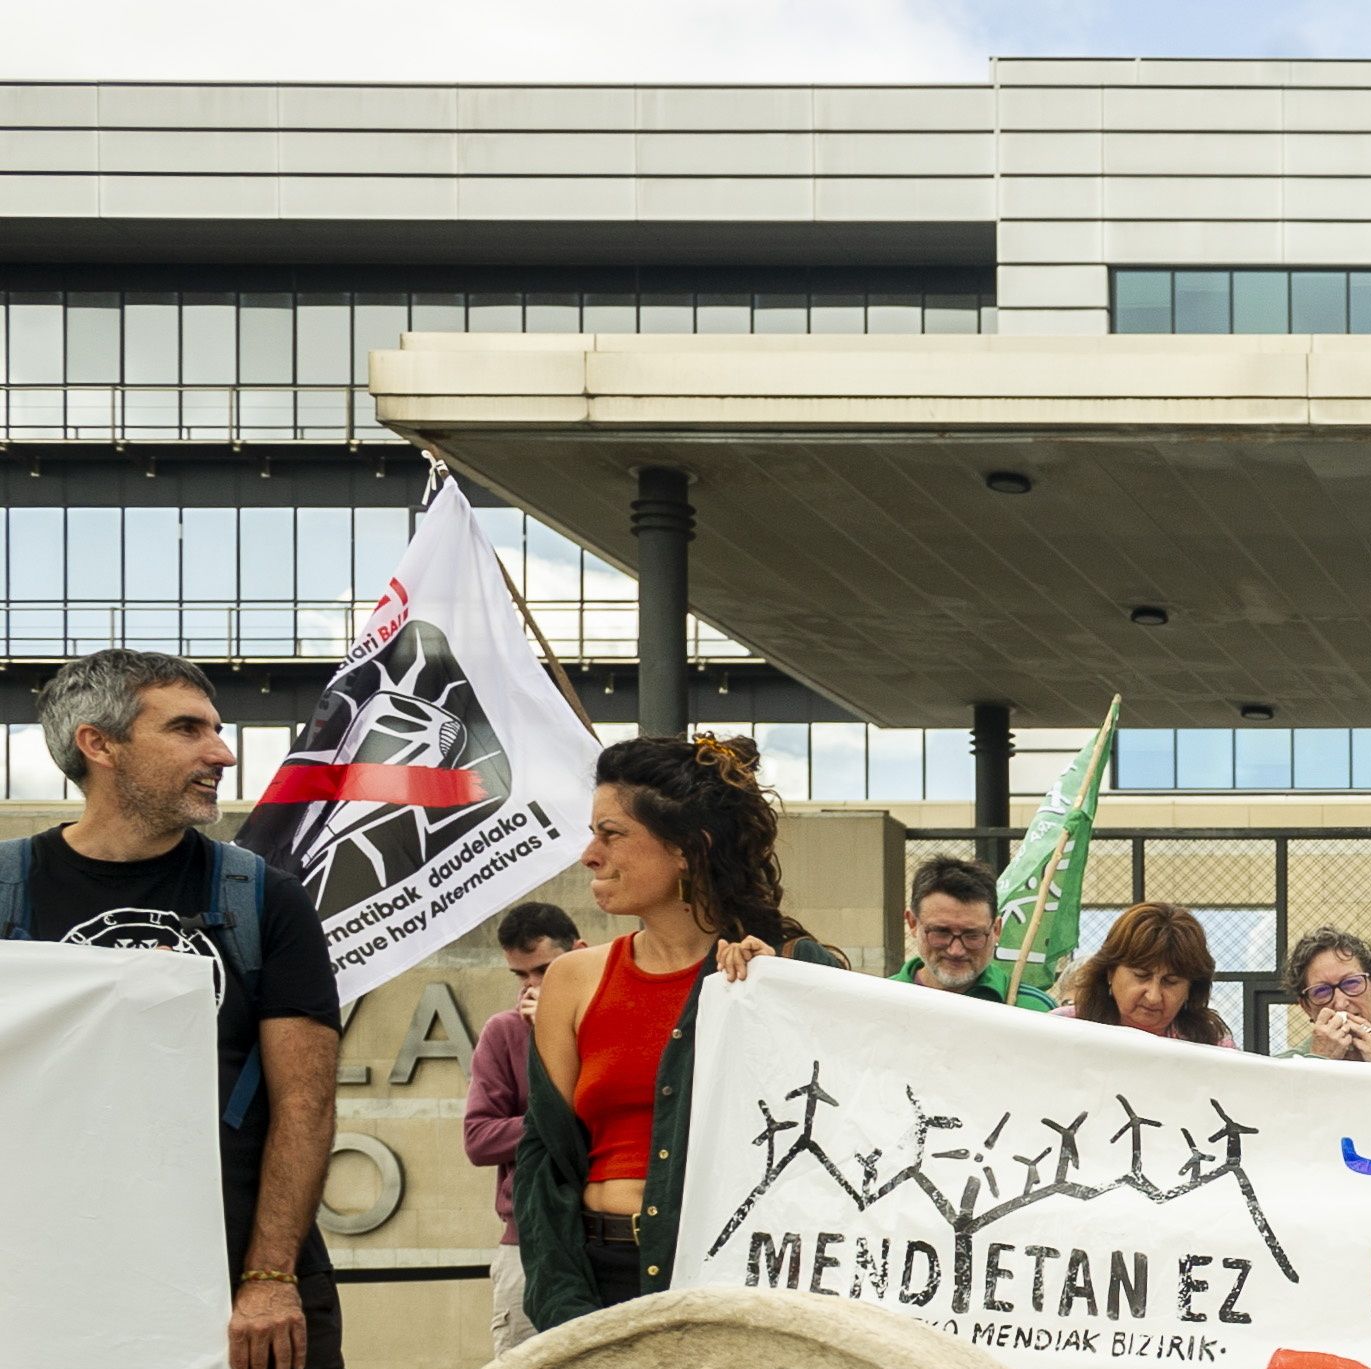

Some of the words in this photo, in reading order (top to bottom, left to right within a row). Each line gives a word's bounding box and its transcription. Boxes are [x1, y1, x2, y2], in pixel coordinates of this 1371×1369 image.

[324, 886, 422, 947] rnatibak
[428, 811, 528, 888] daudelako
[331, 935, 388, 975] orque
[387, 910, 429, 942] hay
[430, 835, 543, 918] Alternativas
[747, 1230, 1149, 1321] MENDIETAN
[1177, 1254, 1253, 1325] EZ
[971, 1322, 1101, 1354] MENDIAK
